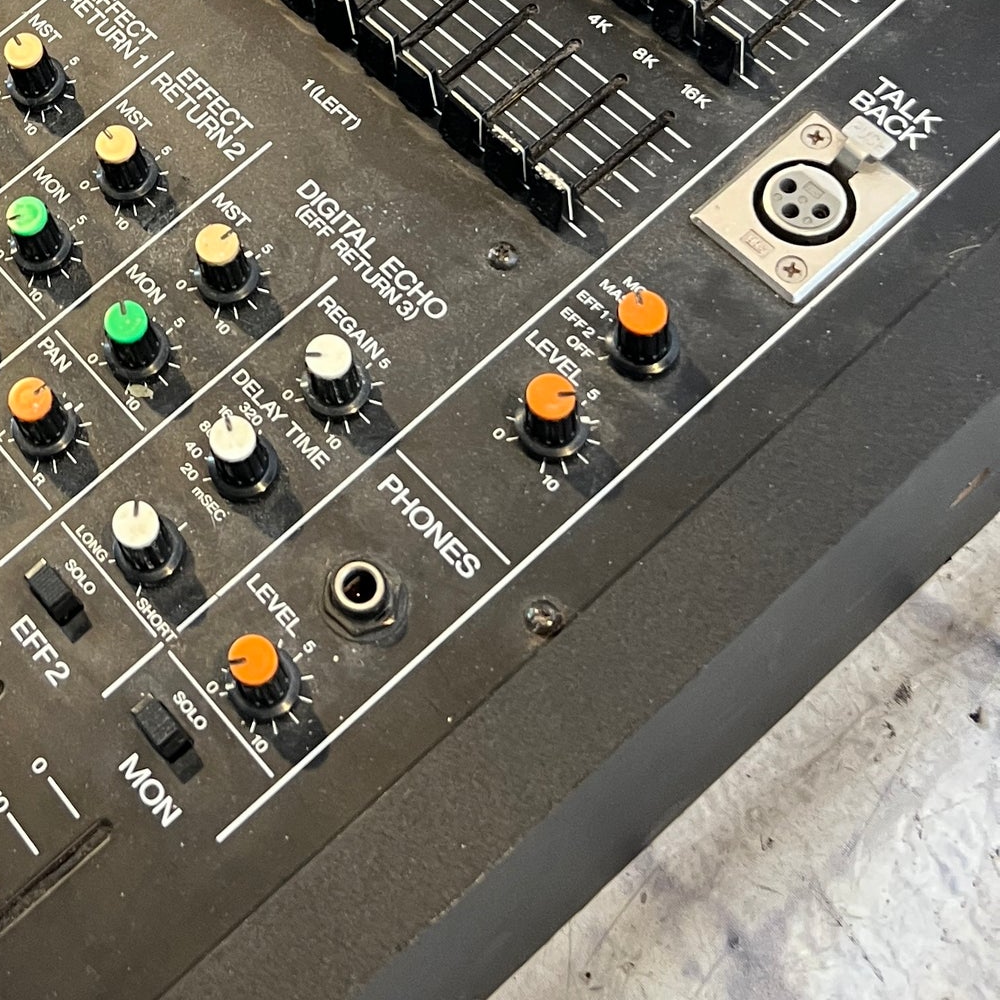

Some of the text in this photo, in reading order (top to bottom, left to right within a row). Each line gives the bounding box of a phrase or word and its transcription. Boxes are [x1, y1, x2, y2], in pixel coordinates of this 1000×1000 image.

[27, 13, 63, 44] MST
[587, 13, 613, 33] 4K
[633, 47, 660, 69] 8K
[115, 99, 153, 131] MST
[174, 66, 255, 135] EFFECT
[680, 82, 712, 109] 16K
[873, 74, 943, 136] TALK
[849, 89, 929, 153] BACK
[32, 165, 71, 204] MON
[211, 192, 252, 229] MST
[296, 178, 448, 319] DIGITAL ECHO
[127, 264, 167, 304] MON
[317, 295, 386, 361] REGAIN
[566, 335, 595, 358] OFF
[36, 334, 74, 376] PAN
[378, 357, 391, 370] 5
[524, 329, 581, 387] LEVEL
[231, 368, 331, 471] DELAY TIME
[238, 401, 263, 426] 320
[185, 441, 204, 459] 40
[180, 462, 199, 481] 20
[75, 523, 108, 561] LONG
[377, 473, 481, 579] PHONES
[64, 558, 96, 596] SOLO
[136, 597, 178, 643] SHORT
[246, 572, 300, 637] LEVEL
[173, 689, 207, 730] SOLO
[31, 756, 49, 775] 0
[118, 752, 183, 828] MON
